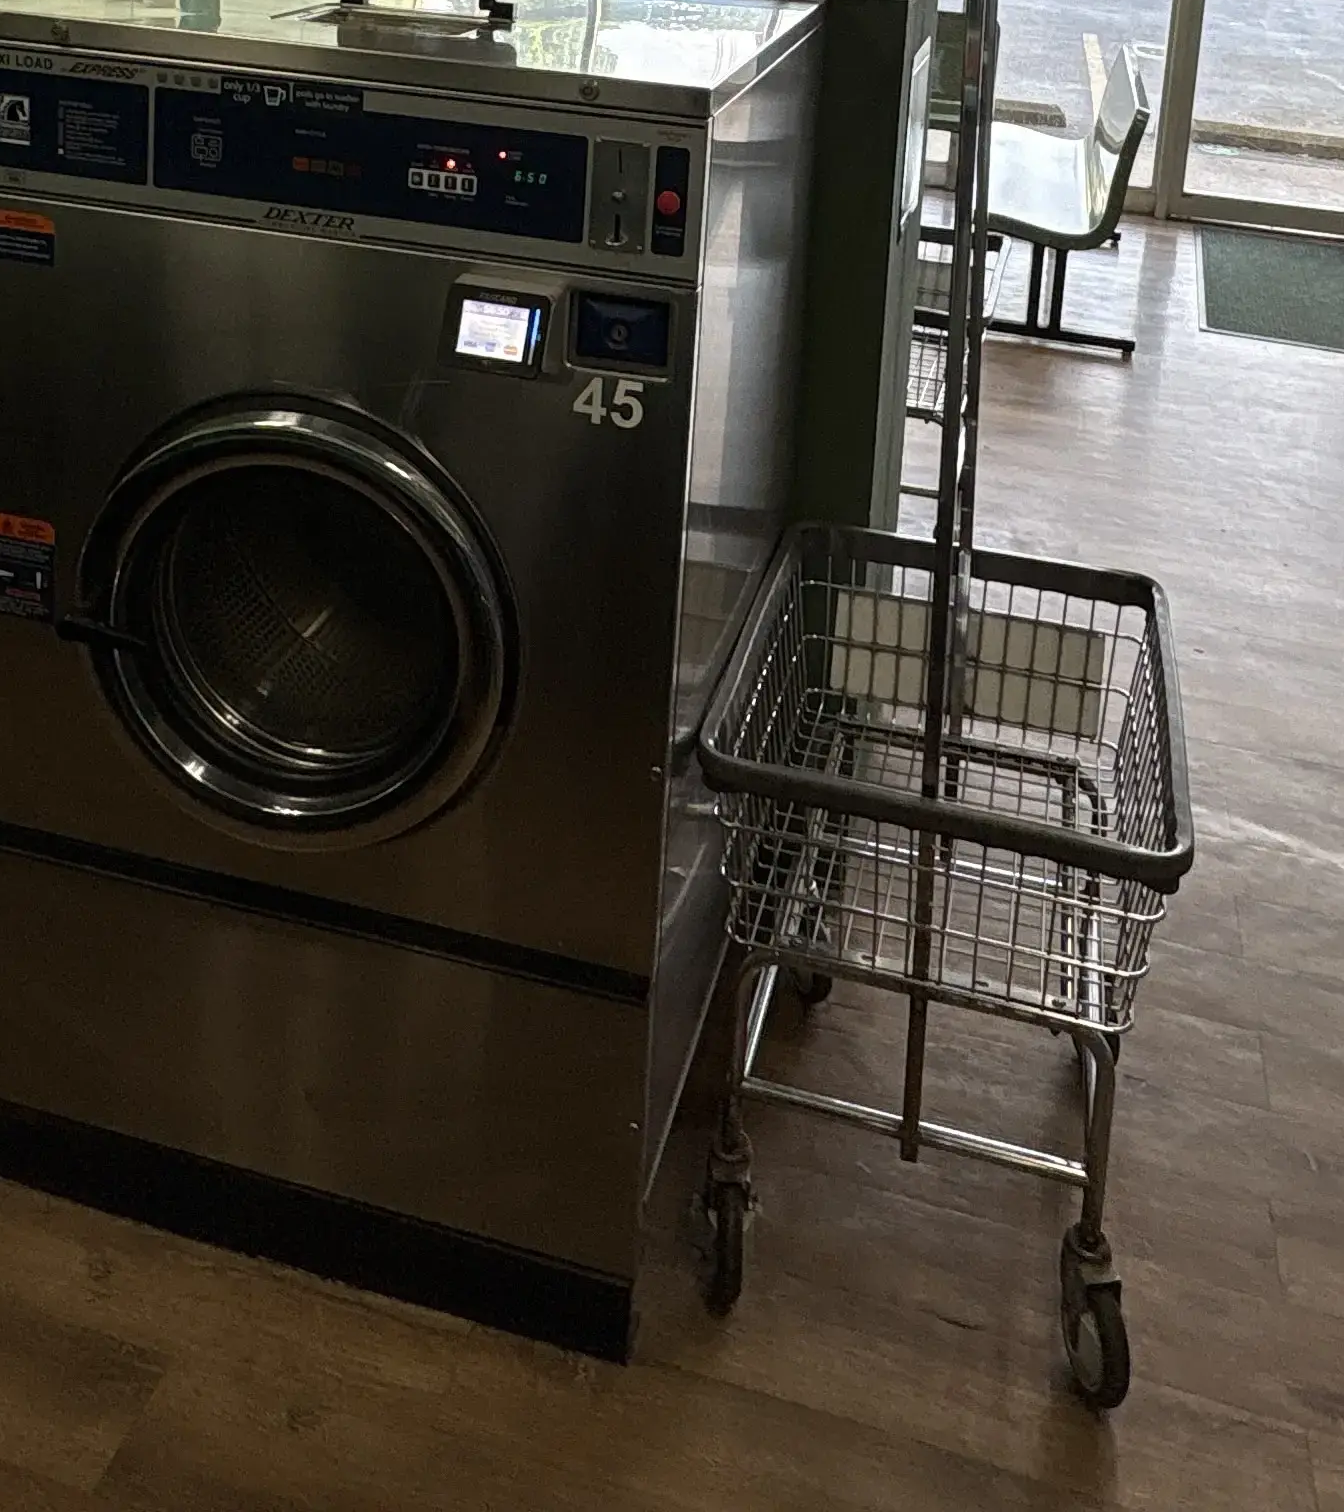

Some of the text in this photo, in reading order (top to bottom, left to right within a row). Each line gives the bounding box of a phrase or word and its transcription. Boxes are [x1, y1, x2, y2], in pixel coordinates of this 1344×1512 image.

[16, 52, 53, 70] LOAD
[68, 61, 139, 80] EXPRESS
[232, 93, 252, 105] cup
[263, 206, 355, 231] DEXTER
[573, 377, 645, 429] 45
